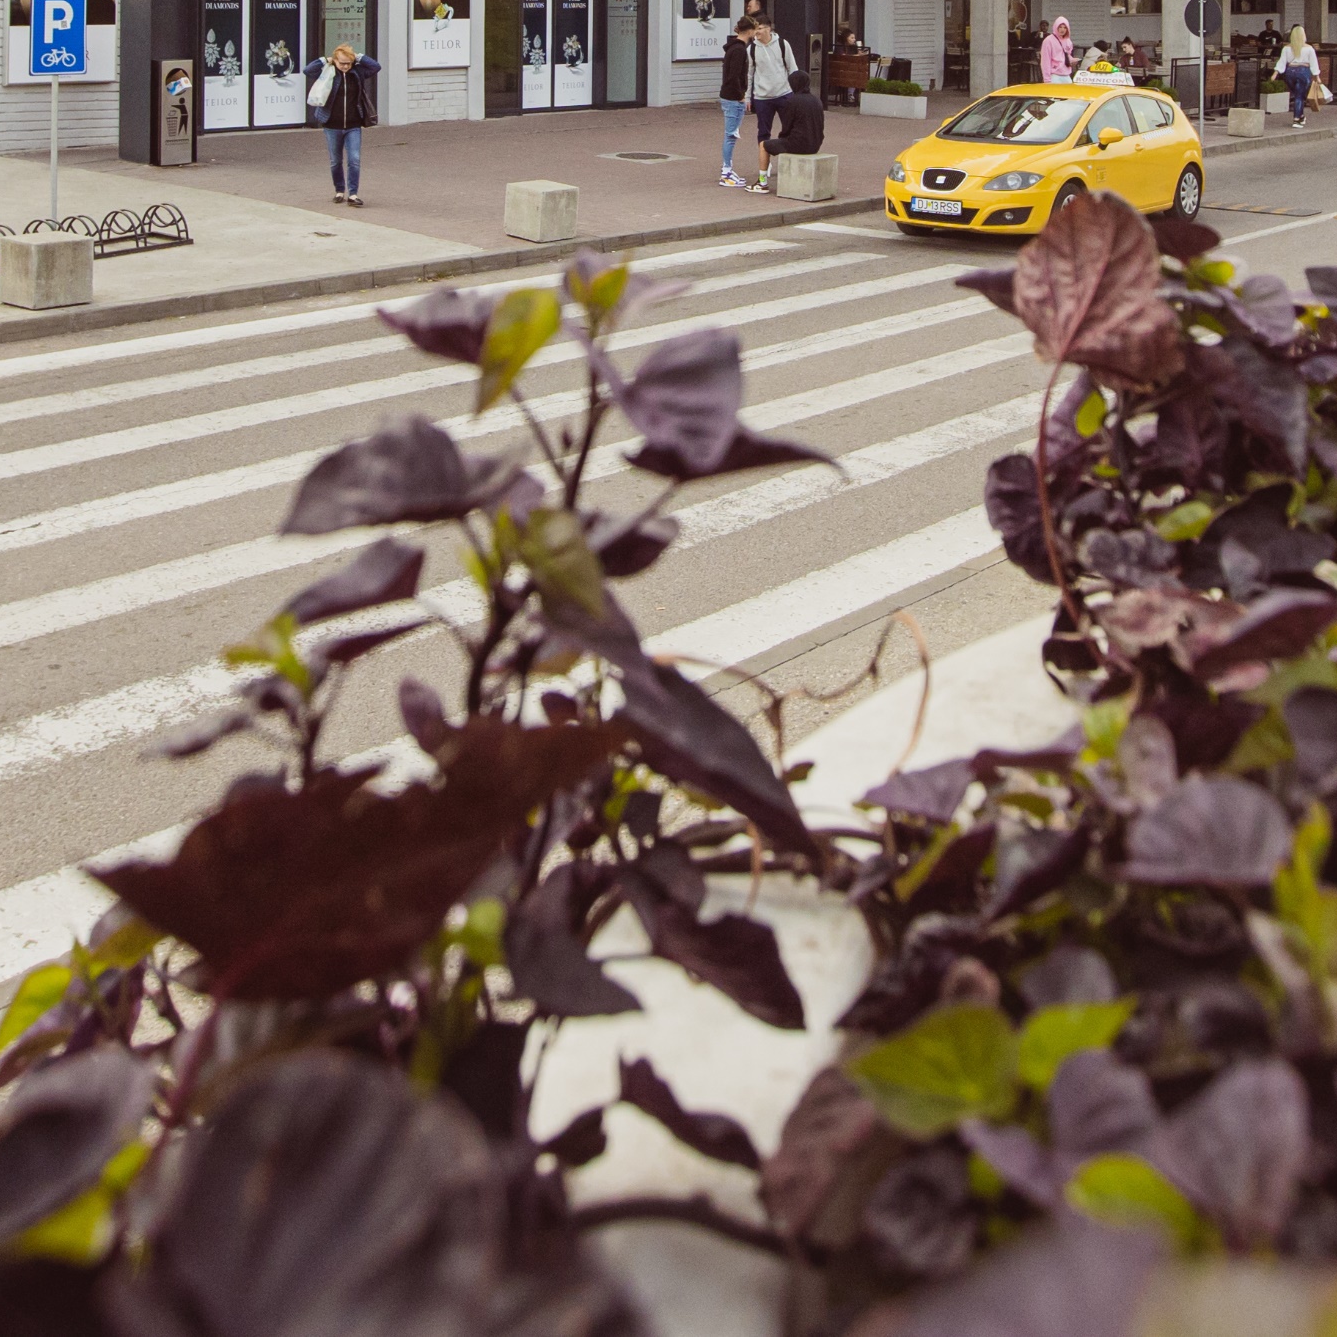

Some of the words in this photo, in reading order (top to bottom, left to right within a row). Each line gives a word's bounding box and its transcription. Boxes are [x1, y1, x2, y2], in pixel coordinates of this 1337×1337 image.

[205, 2, 240, 10] DIAMONDS
[265, 2, 298, 10] DIAMONDS
[44, 0, 74, 44] P
[423, 40, 462, 50] TEILOR
[690, 38, 718, 47] TEILOR
[205, 97, 239, 107] TEILOR
[264, 94, 297, 105] TEILOR
[917, 199, 928, 210] DJ
[931, 201, 939, 211] 13
[939, 202, 959, 213] RSS
